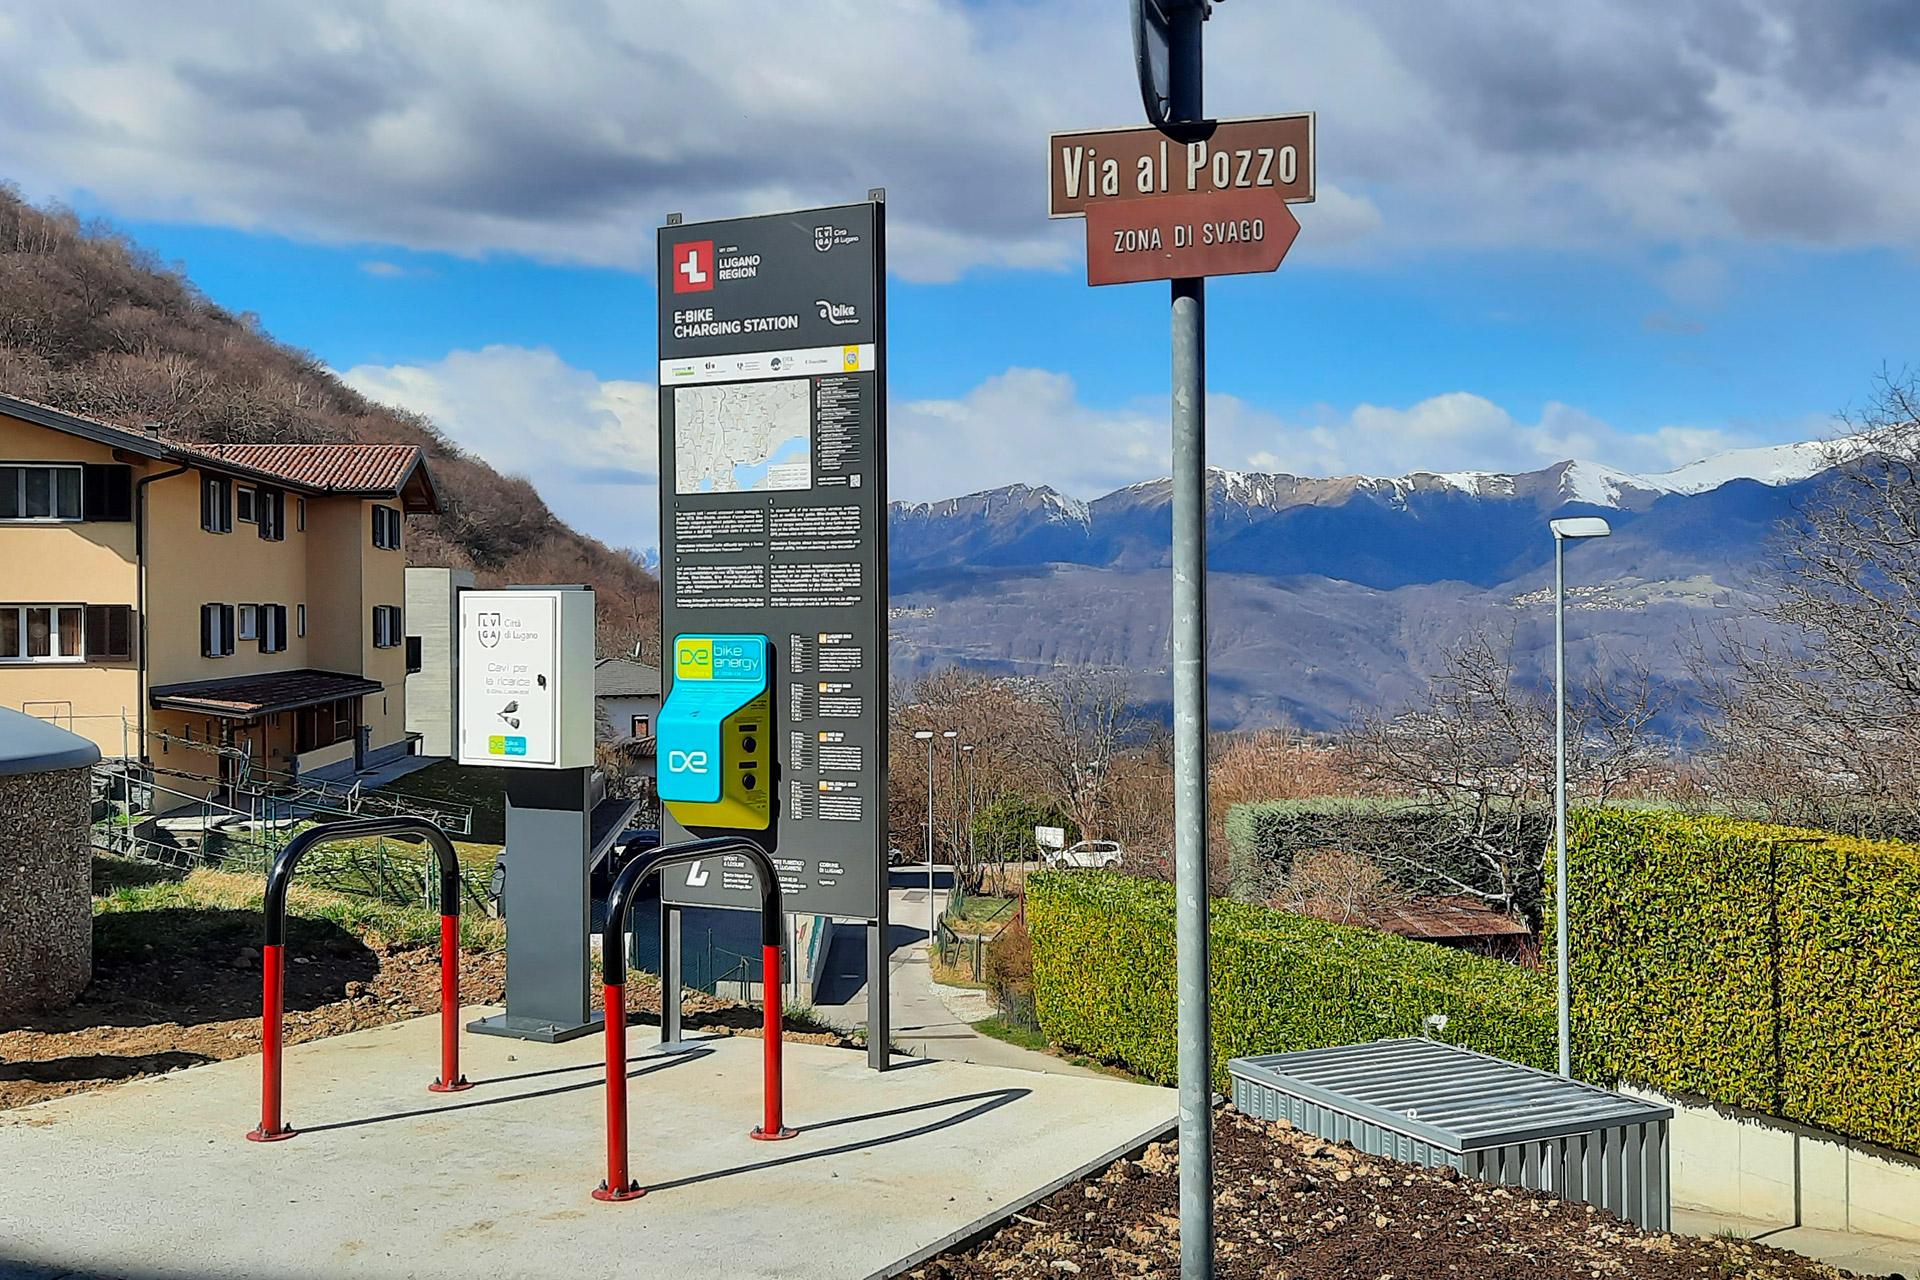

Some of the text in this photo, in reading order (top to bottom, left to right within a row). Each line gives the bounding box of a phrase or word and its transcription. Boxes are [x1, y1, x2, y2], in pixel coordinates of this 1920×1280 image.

[1062, 140, 1298, 198] Via al Pozzo
[1113, 218, 1265, 253] ZONA DI SVAGO
[719, 254, 761, 269] LUGANO
[719, 266, 756, 280] REGION
[674, 307, 713, 324] E-BIKE
[674, 315, 798, 338] CHARGING STATION
[504, 618, 521, 628] Città
[504, 630, 538, 642] di Lugano
[713, 644, 743, 657] bike
[487, 662, 528, 674] Cavi per
[713, 657, 759, 671] energy
[485, 676, 494, 686] la
